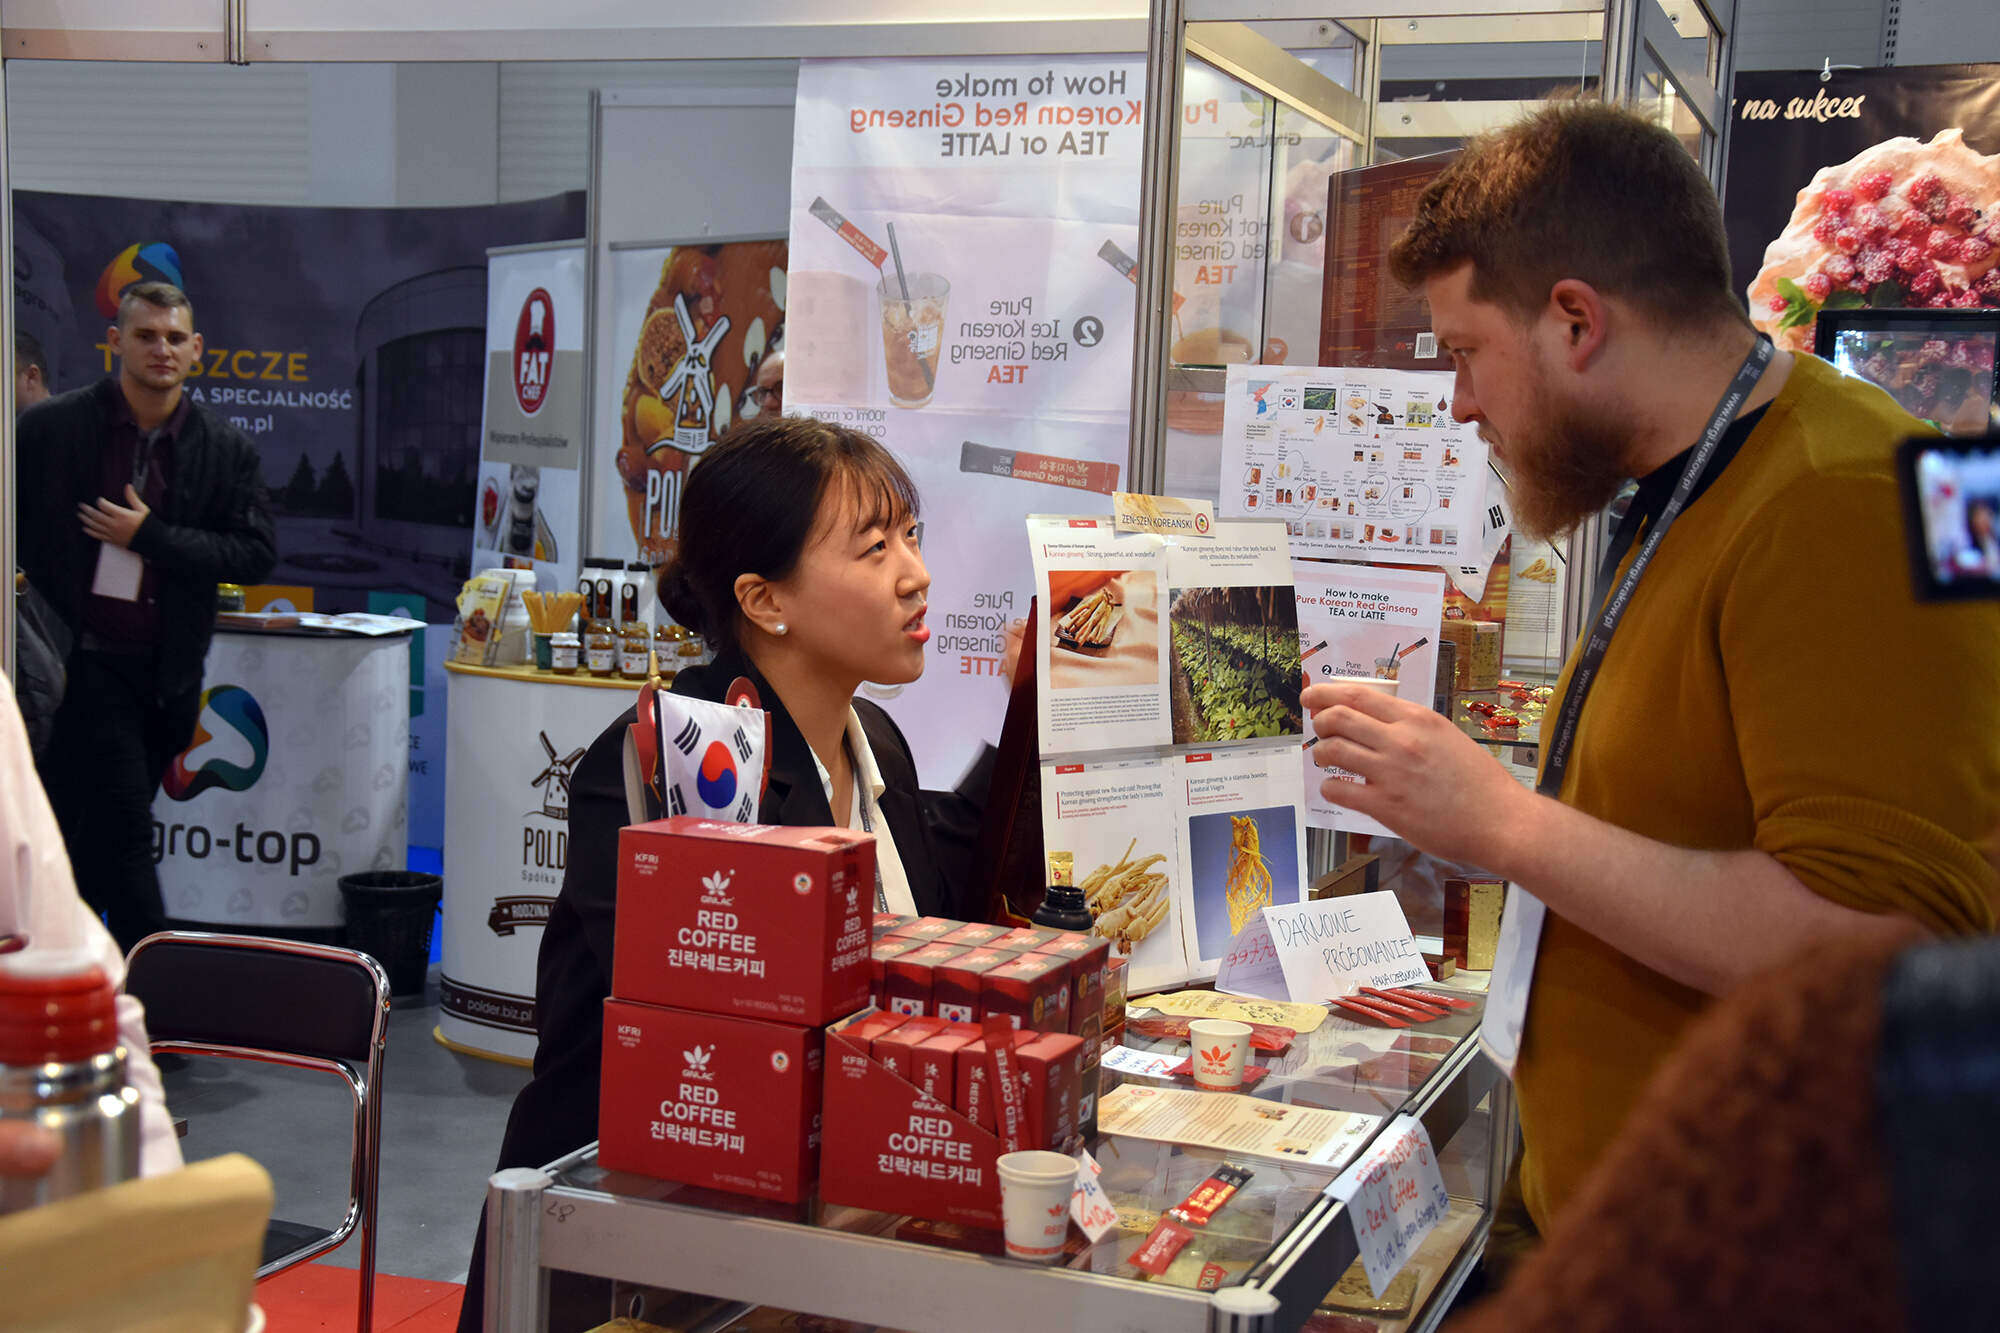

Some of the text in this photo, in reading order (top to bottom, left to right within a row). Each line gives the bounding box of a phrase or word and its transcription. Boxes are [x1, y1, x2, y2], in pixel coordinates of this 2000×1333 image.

[1741, 87, 1866, 123] na sukces
[520, 352, 549, 385] FAT
[211, 387, 353, 410] SPECJALNOŚĆ
[1681, 392, 1741, 490] www.targi.krakow.pl
[1604, 531, 1662, 629] www.targi.krakow.pl
[1296, 594, 1418, 616] Pure Korean Red Ginseng
[1326, 588, 1389, 602] How to make
[1329, 607, 1345, 616] TEA
[1360, 610, 1386, 620] LATTE
[697, 909, 738, 931] RED
[844, 916, 861, 933] RED
[677, 927, 757, 953] COFFEE
[836, 928, 867, 952] COFFEE
[667, 949, 766, 978] 진락레드커피
[467, 999, 533, 1023] polder.biz.pl
[617, 1025, 641, 1036] KFRI
[679, 1083, 719, 1105] RED
[995, 1047, 1017, 1135] RED COFFEE
[660, 1100, 737, 1129] COFFEE
[909, 1116, 953, 1138] RED
[650, 1120, 745, 1154] 진락레드커피
[888, 1133, 973, 1162] COFFEE
[878, 1154, 983, 1187] 진락레드커피
